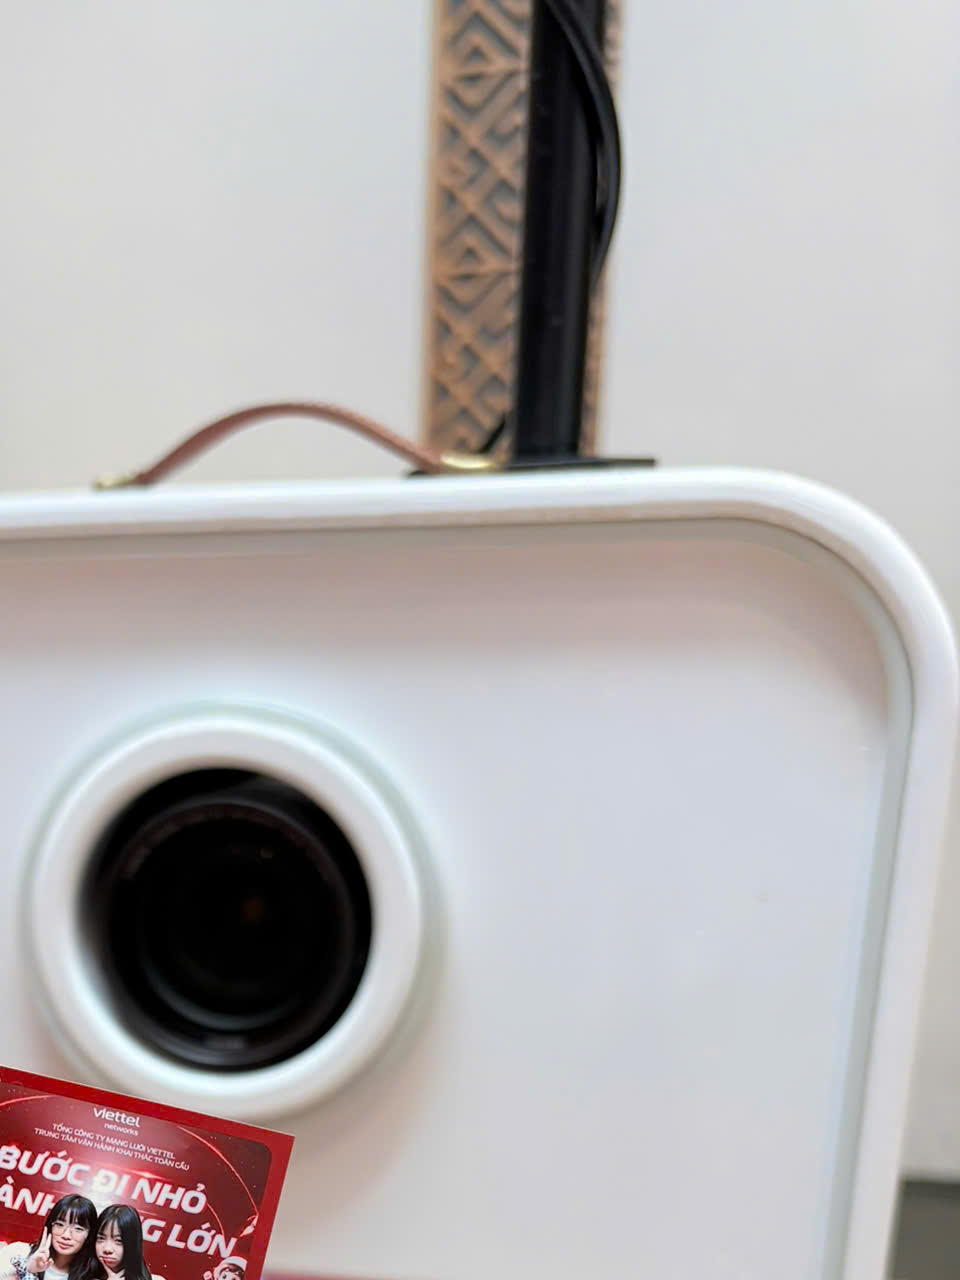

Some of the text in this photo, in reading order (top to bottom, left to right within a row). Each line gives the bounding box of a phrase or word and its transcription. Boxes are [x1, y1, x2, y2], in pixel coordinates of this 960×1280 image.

[94, 1108, 140, 1127] viettel
[35, 1128, 60, 1139] TRUNG
[74, 1128, 94, 1139] CÔNG
[95, 1134, 106, 1142] TY
[146, 1146, 175, 1159] VIETTEL
[90, 1166, 127, 1197] ĐI
[132, 1172, 206, 1213] NHỎ
[167, 1223, 236, 1262] LỚN
